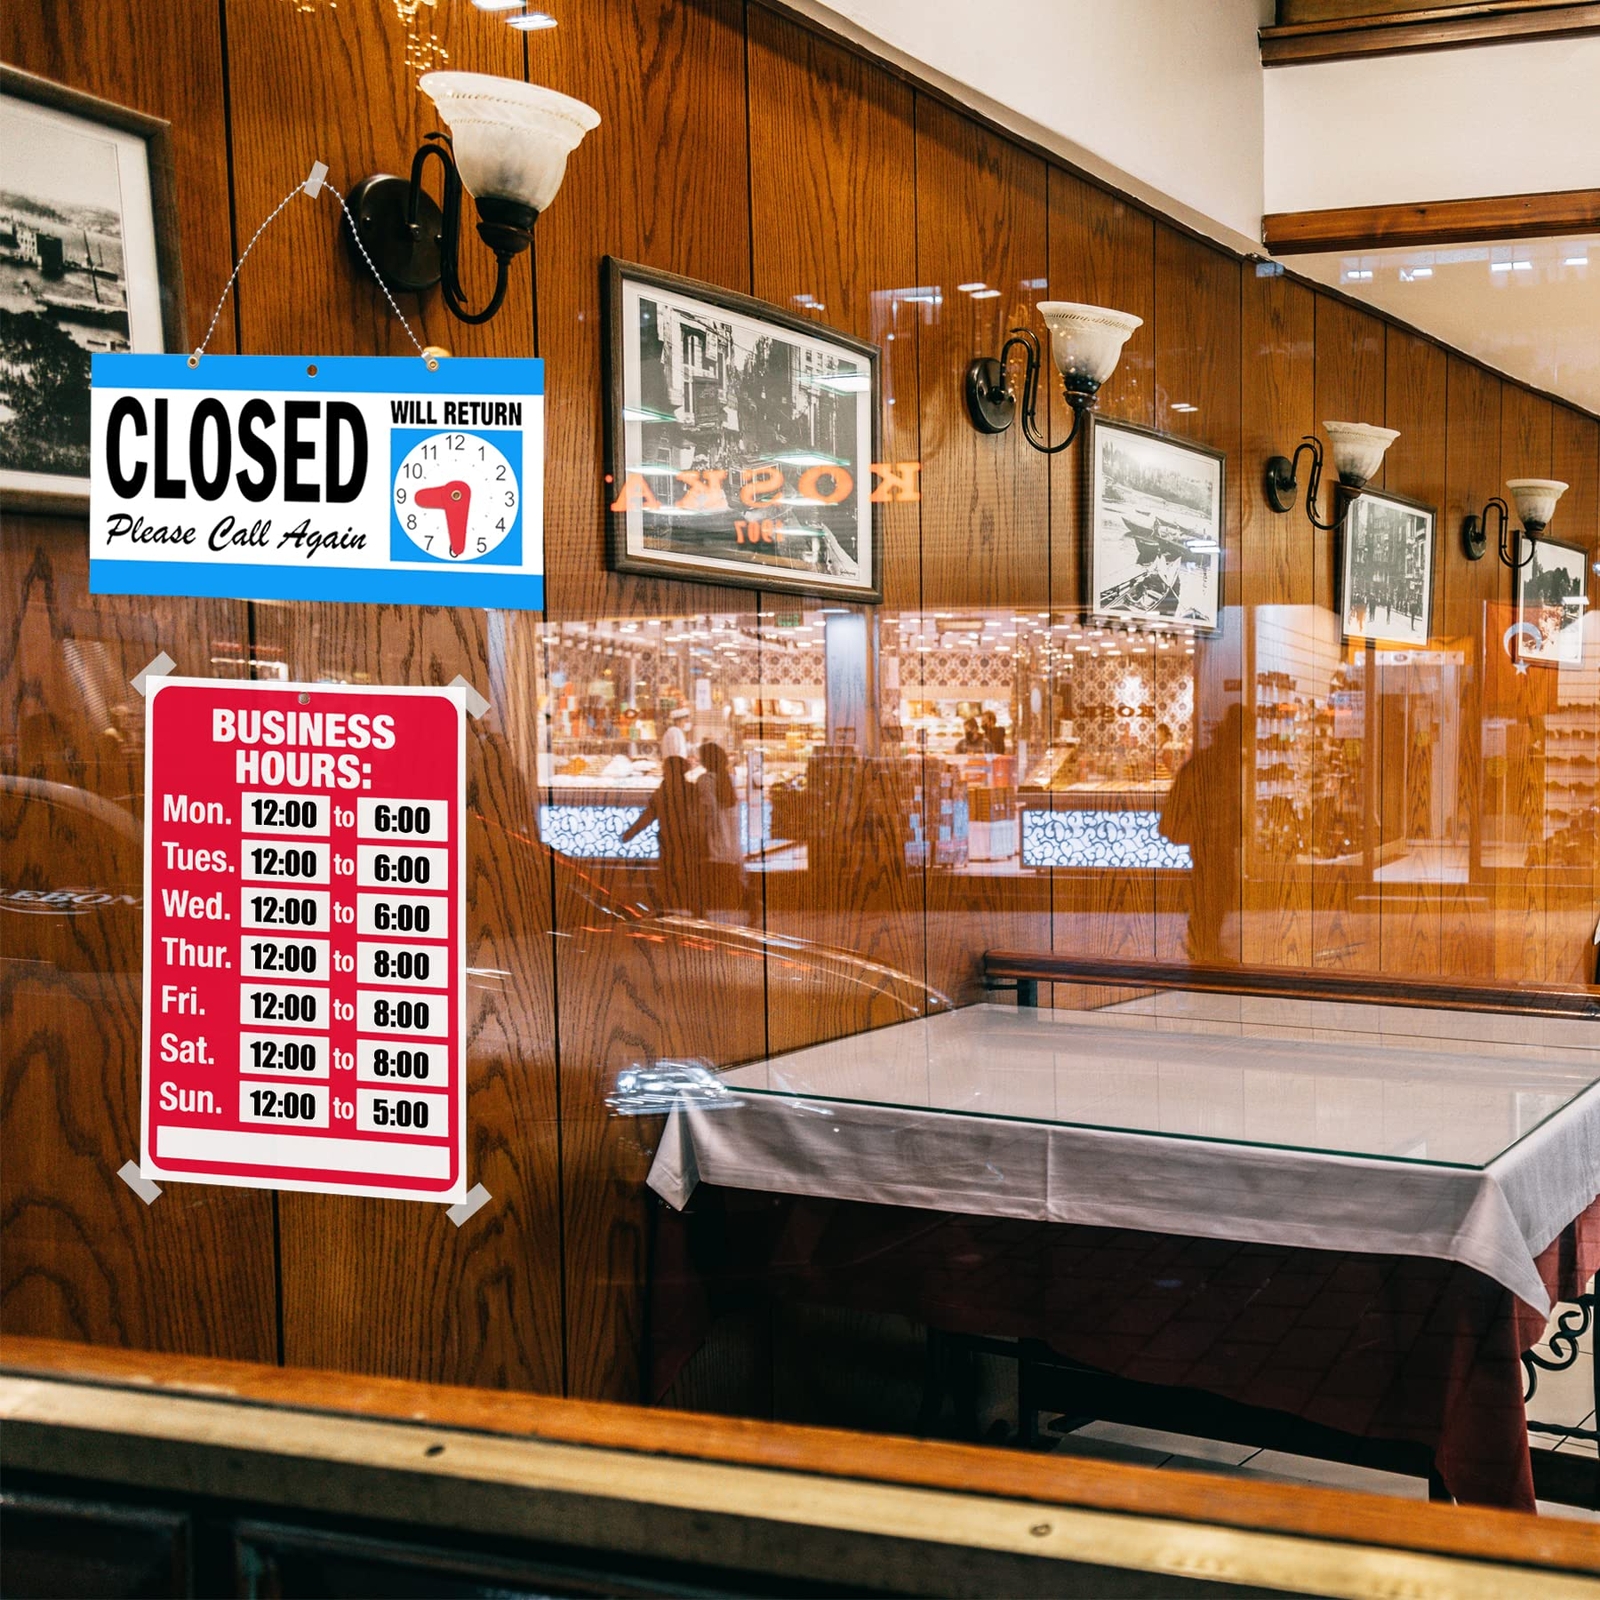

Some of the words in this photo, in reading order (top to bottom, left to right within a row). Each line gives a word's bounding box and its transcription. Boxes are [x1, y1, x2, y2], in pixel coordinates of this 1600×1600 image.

[391, 401, 437, 424] WILL
[445, 402, 521, 425] RETURN
[106, 396, 368, 503] CLOSED
[420, 444, 437, 460] 11
[445, 434, 466, 451] 12
[478, 445, 485, 462] 1
[402, 462, 423, 480] 10
[495, 464, 507, 482] 2
[396, 487, 407, 505] 9
[504, 490, 515, 508] 3
[406, 513, 418, 531] 8
[494, 516, 506, 533] 4
[107, 513, 196, 545] Please
[208, 516, 271, 551] Call
[277, 519, 366, 558] Again
[424, 534, 435, 551] 7
[476, 536, 488, 554] 5
[213, 709, 395, 749] BUSINESS
[236, 750, 371, 789] HOURS:
[164, 794, 231, 824] Mon.
[252, 799, 316, 828] 12:00
[334, 806, 354, 827] to
[374, 804, 431, 834] 6:00
[162, 842, 234, 872] Tues.
[251, 848, 316, 877] 12:00
[334, 854, 354, 875] to
[374, 854, 431, 883] 6:00
[162, 889, 230, 920] Wed.
[251, 897, 316, 925] 12:00
[333, 902, 354, 923] to
[374, 903, 431, 932] 6:00
[162, 937, 231, 968] Thur.
[251, 944, 316, 973] 12:00
[333, 951, 354, 972] to
[374, 950, 431, 980] 8:00
[162, 985, 204, 1015] Fri.
[251, 993, 316, 1022] 12:00
[333, 999, 354, 1020] to
[374, 999, 431, 1029] 8:00
[161, 1033, 214, 1064] Sat.
[250, 1042, 315, 1071] 12:00
[333, 1048, 354, 1070] to
[374, 1049, 431, 1079] 8:00
[160, 1082, 221, 1113] Sun.
[250, 1091, 315, 1119] 12:00
[333, 1097, 354, 1119] to
[374, 1099, 431, 1128] 5:00
